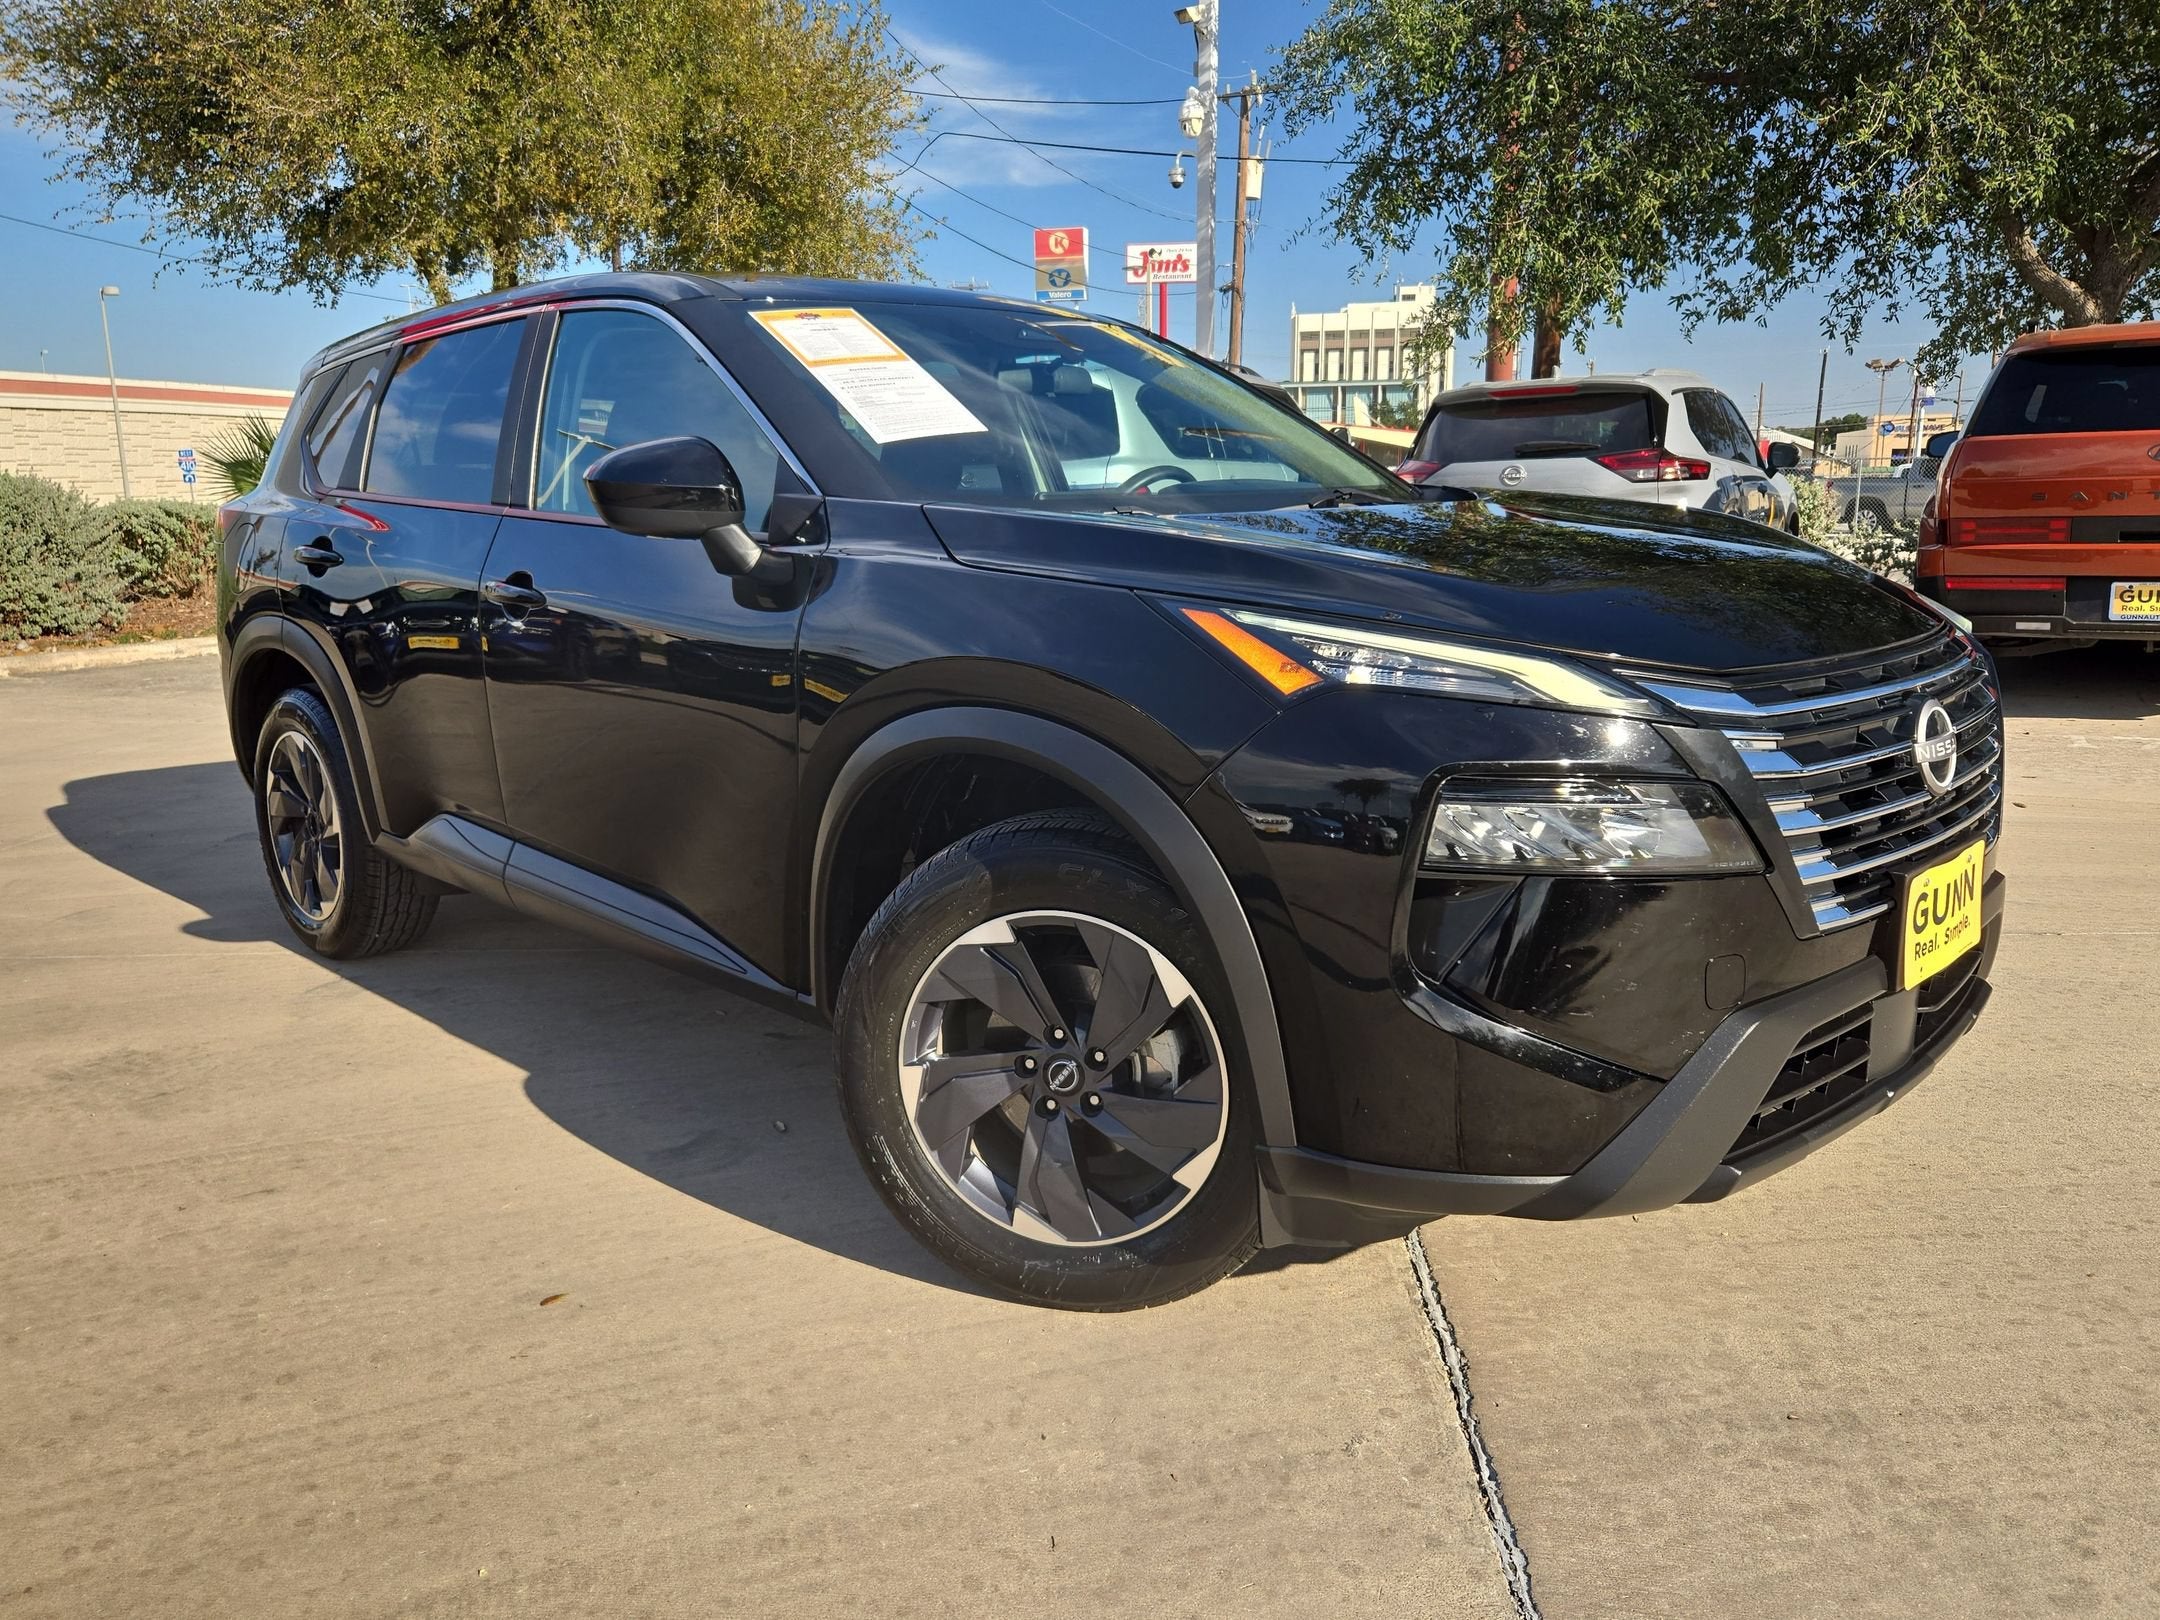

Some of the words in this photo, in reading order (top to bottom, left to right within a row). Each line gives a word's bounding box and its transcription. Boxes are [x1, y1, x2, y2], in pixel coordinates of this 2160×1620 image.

[1133, 251, 1190, 277] Jim's
[1048, 291, 1072, 299] Valero
[181, 461, 195, 470] 410
[2119, 589, 2160, 603] GU
[2121, 604, 2146, 612] Real.
[1913, 863, 1976, 935] GUNN
[1915, 933, 1940, 961] Real.
[1944, 914, 1971, 945] Simple.
[1050, 1061, 1077, 1090] NISSAN
